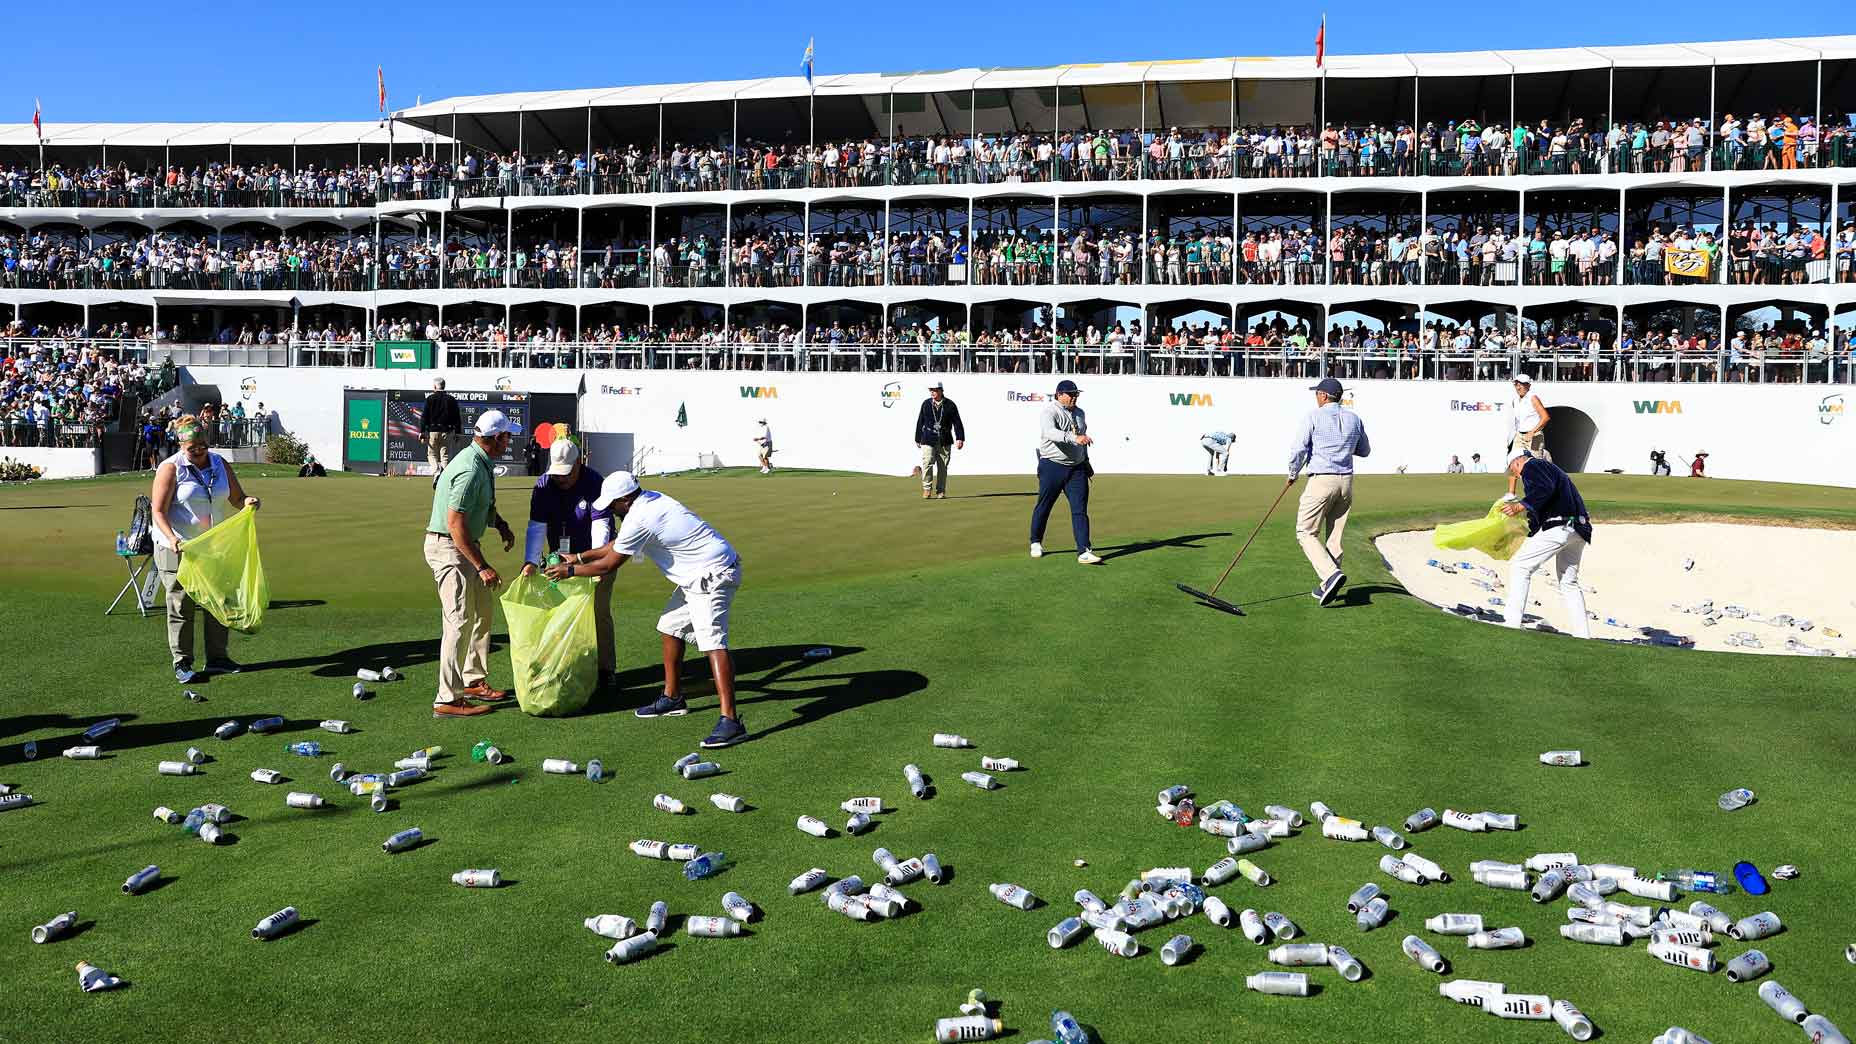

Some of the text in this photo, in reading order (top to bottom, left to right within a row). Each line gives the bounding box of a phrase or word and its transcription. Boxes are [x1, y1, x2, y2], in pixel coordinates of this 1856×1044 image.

[609, 386, 633, 395] FedEx
[739, 386, 778, 398] WM
[1016, 392, 1045, 402] FedEx
[1169, 392, 1213, 406] WM
[1461, 402, 1492, 412] FedEx
[1632, 400, 1683, 413] WM
[349, 430, 380, 440] ROLEX
[389, 441, 405, 449] SAM
[389, 450, 412, 459] RYDER
[1504, 999, 1531, 1015] lite
[960, 1025, 985, 1040] lite
